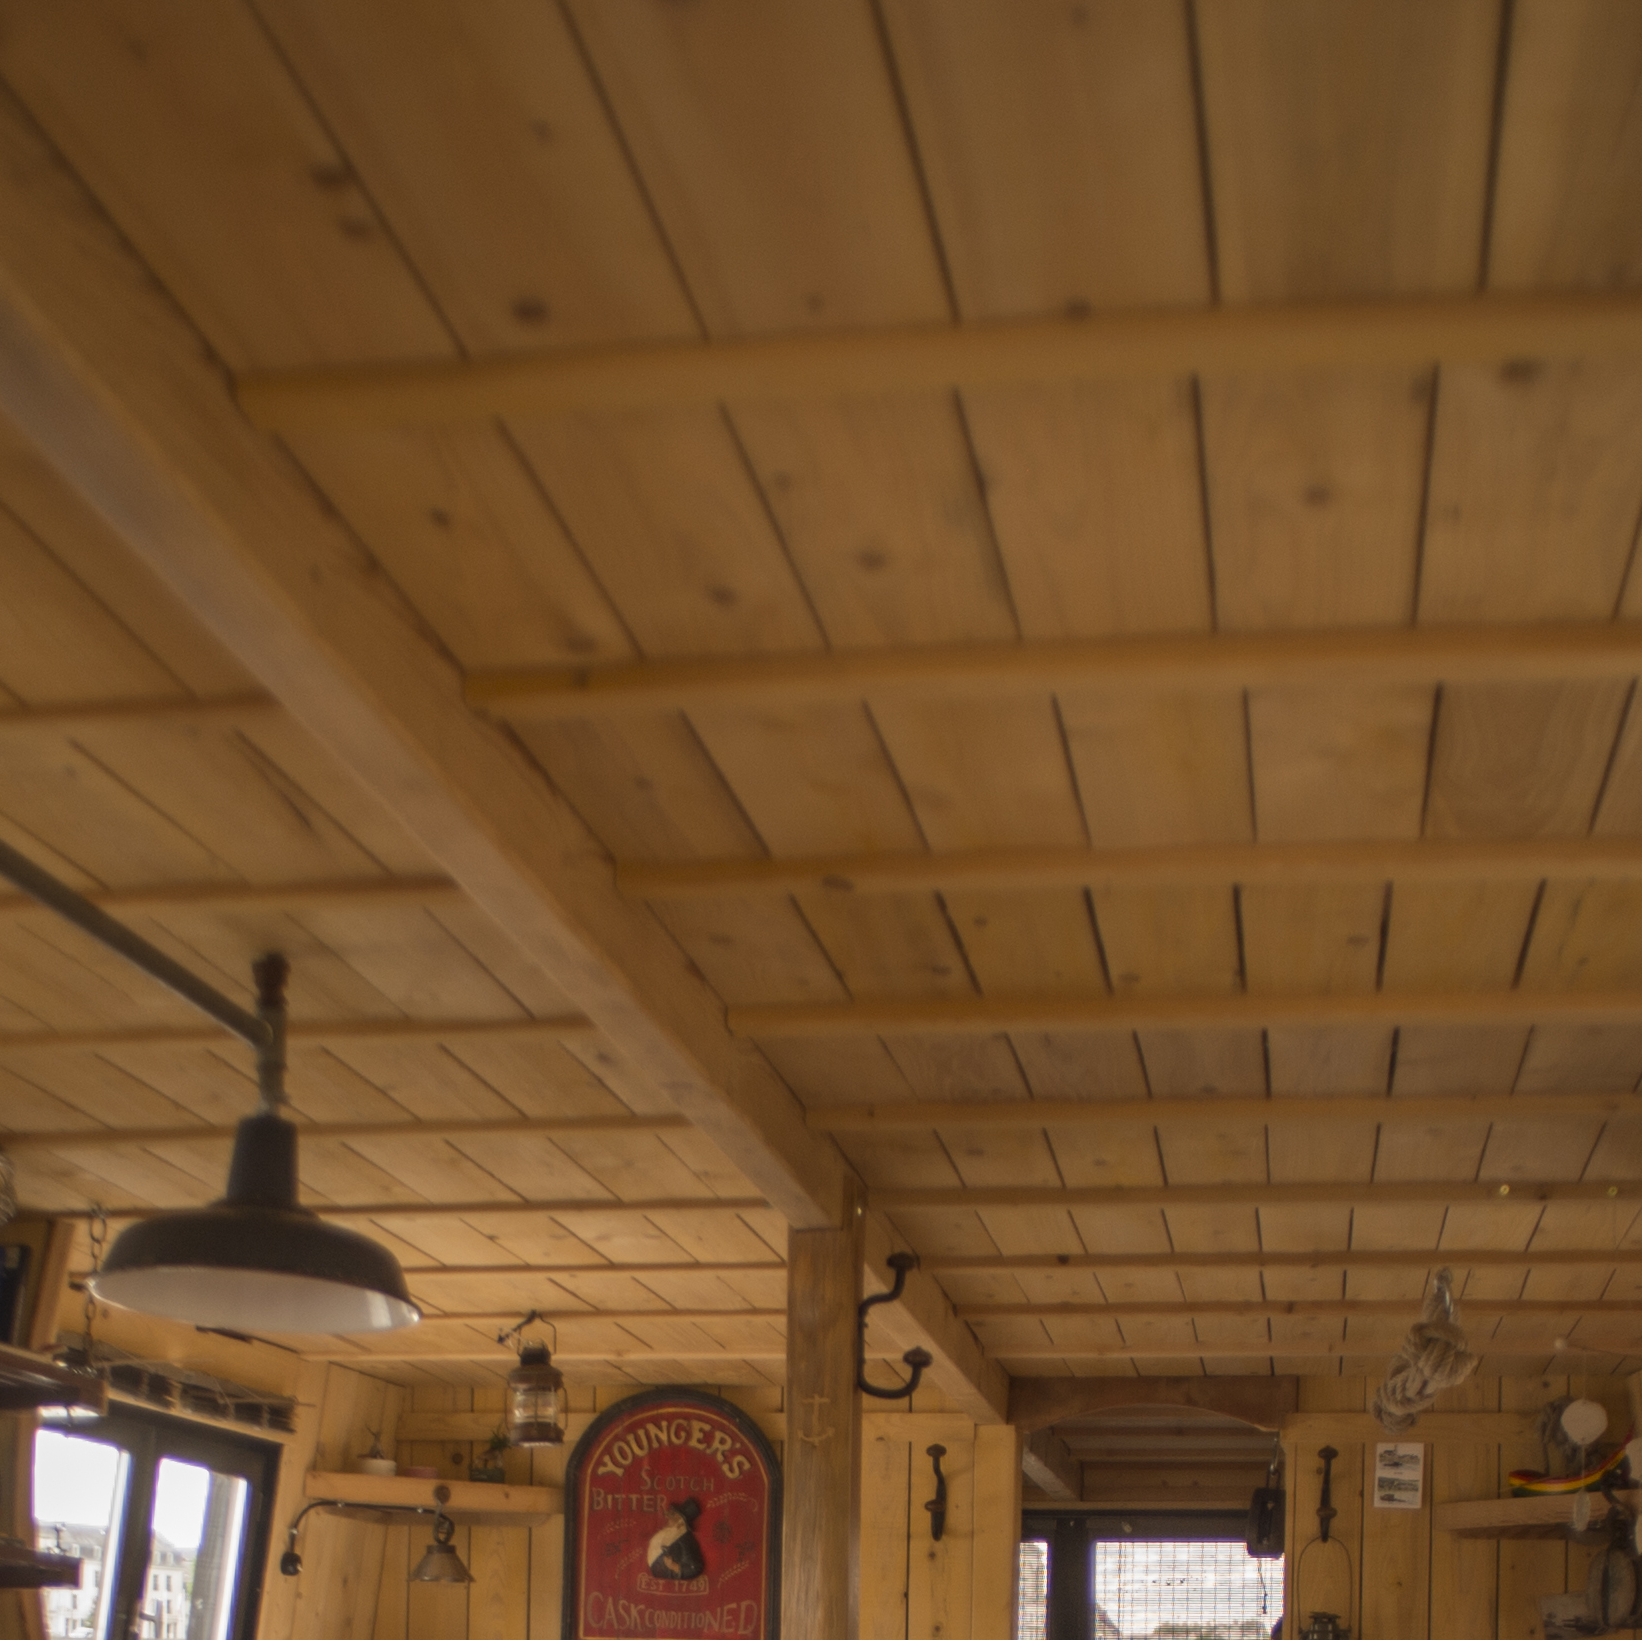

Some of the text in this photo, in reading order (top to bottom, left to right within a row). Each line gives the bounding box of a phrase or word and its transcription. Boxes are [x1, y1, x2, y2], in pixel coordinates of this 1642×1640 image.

[597, 1419, 751, 1479] YOUNGER'S
[592, 1488, 668, 1513] BITTER
[641, 1579, 705, 1592] EST 1749
[586, 1591, 757, 1635] CASK CONDITIONED
